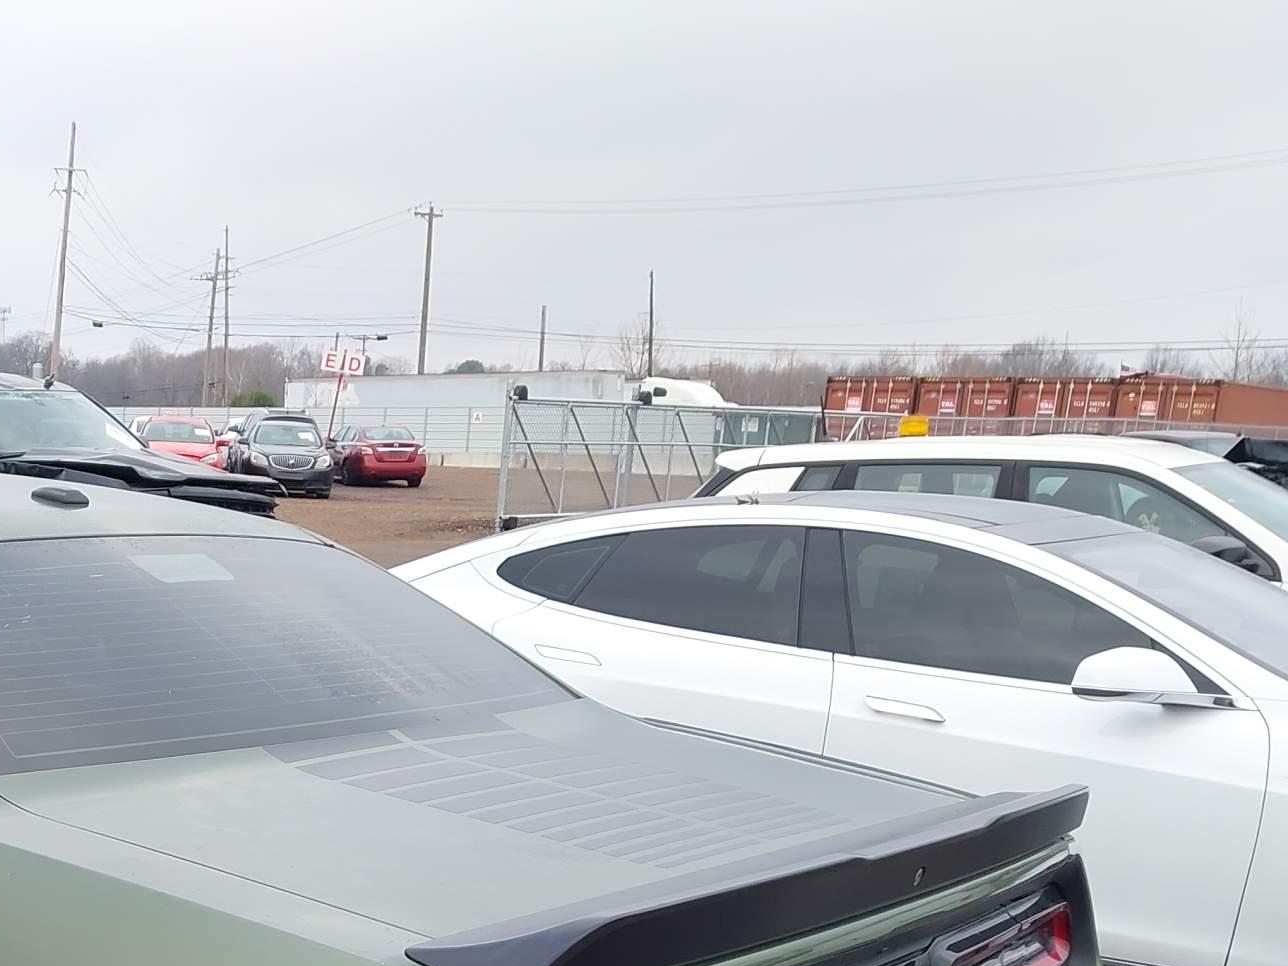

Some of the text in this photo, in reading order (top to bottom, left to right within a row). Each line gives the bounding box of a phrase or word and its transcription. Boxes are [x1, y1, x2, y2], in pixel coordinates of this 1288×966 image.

[325, 353, 361, 372] E D
[474, 413, 481, 422] A
